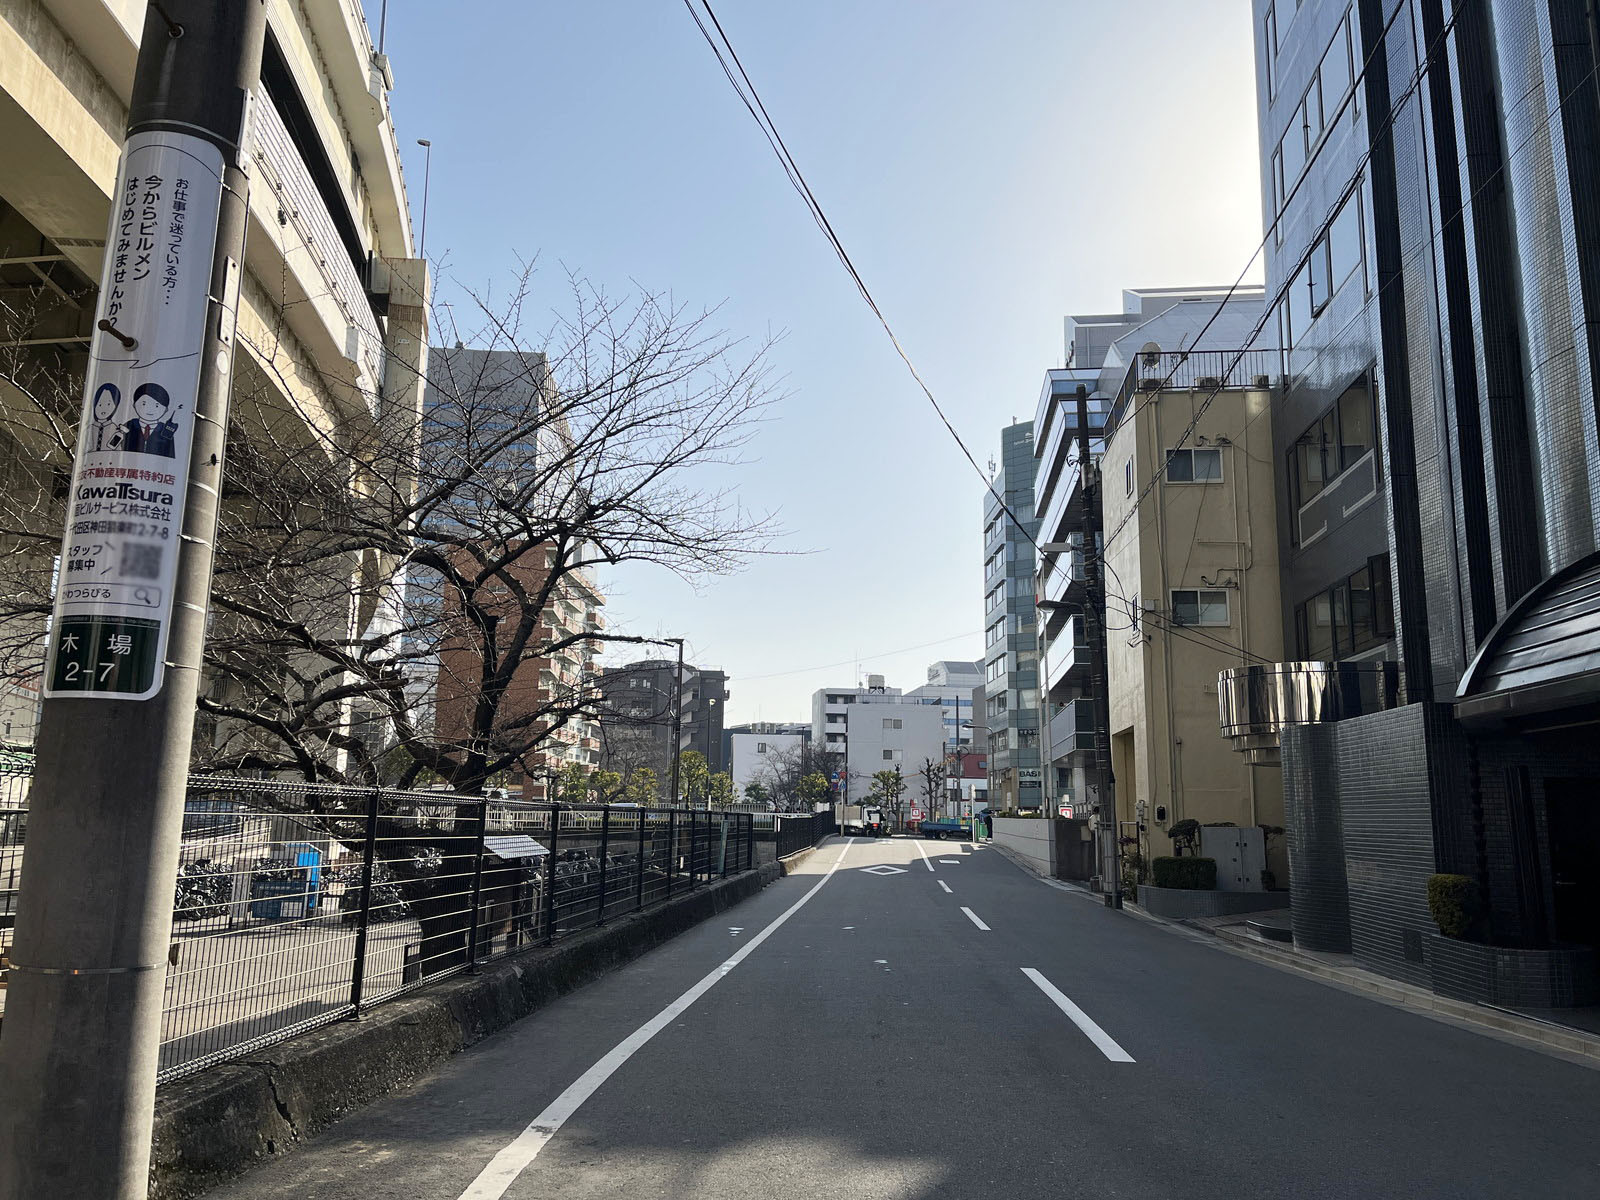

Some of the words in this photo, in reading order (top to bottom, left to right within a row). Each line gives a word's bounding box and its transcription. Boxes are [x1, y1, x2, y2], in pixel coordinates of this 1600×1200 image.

[132, 174, 163, 281] 今からビルメン
[67, 544, 103, 557] スタッフ
[67, 558, 95, 573] 募集中
[60, 632, 133, 656] 木場
[64, 661, 116, 683] 2-7
